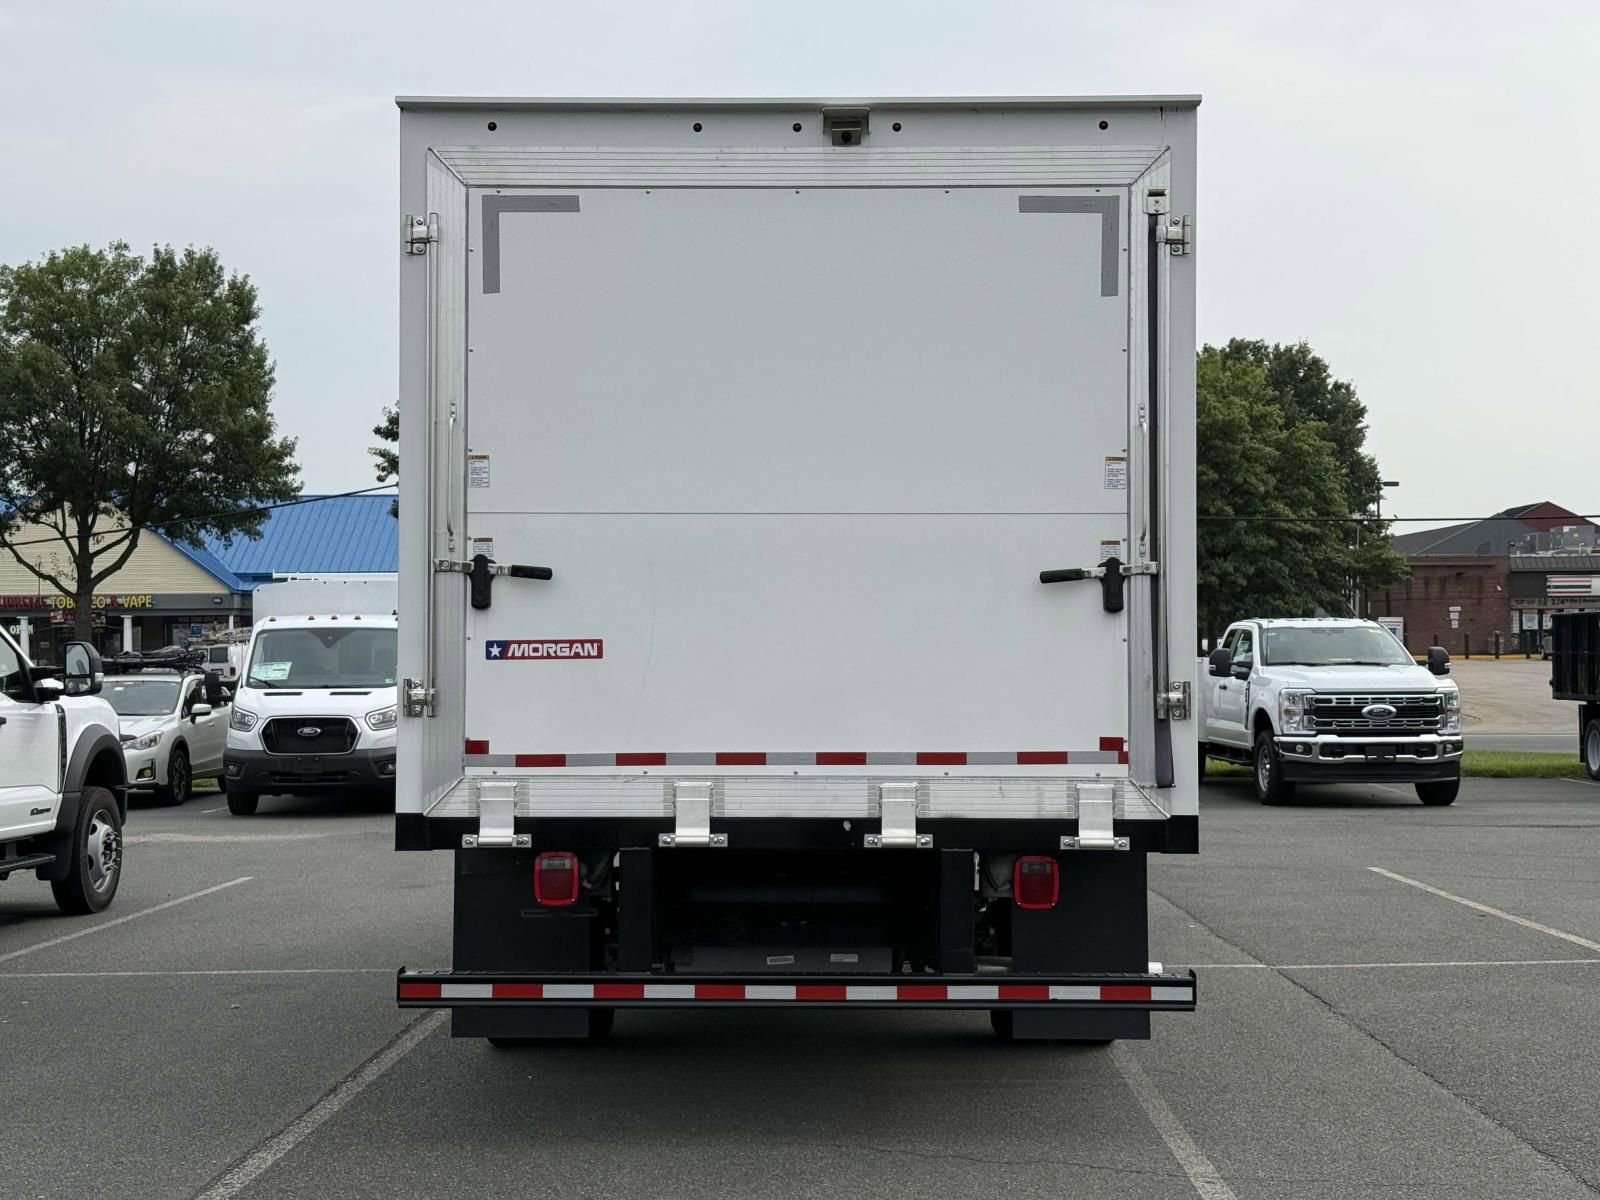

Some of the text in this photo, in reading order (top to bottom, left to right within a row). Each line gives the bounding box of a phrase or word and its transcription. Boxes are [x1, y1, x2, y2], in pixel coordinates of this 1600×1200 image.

[50, 596, 105, 608] TOBCO
[123, 595, 152, 608] VAPE
[9, 624, 34, 635] OPN
[507, 642, 598, 657] MORGAN
